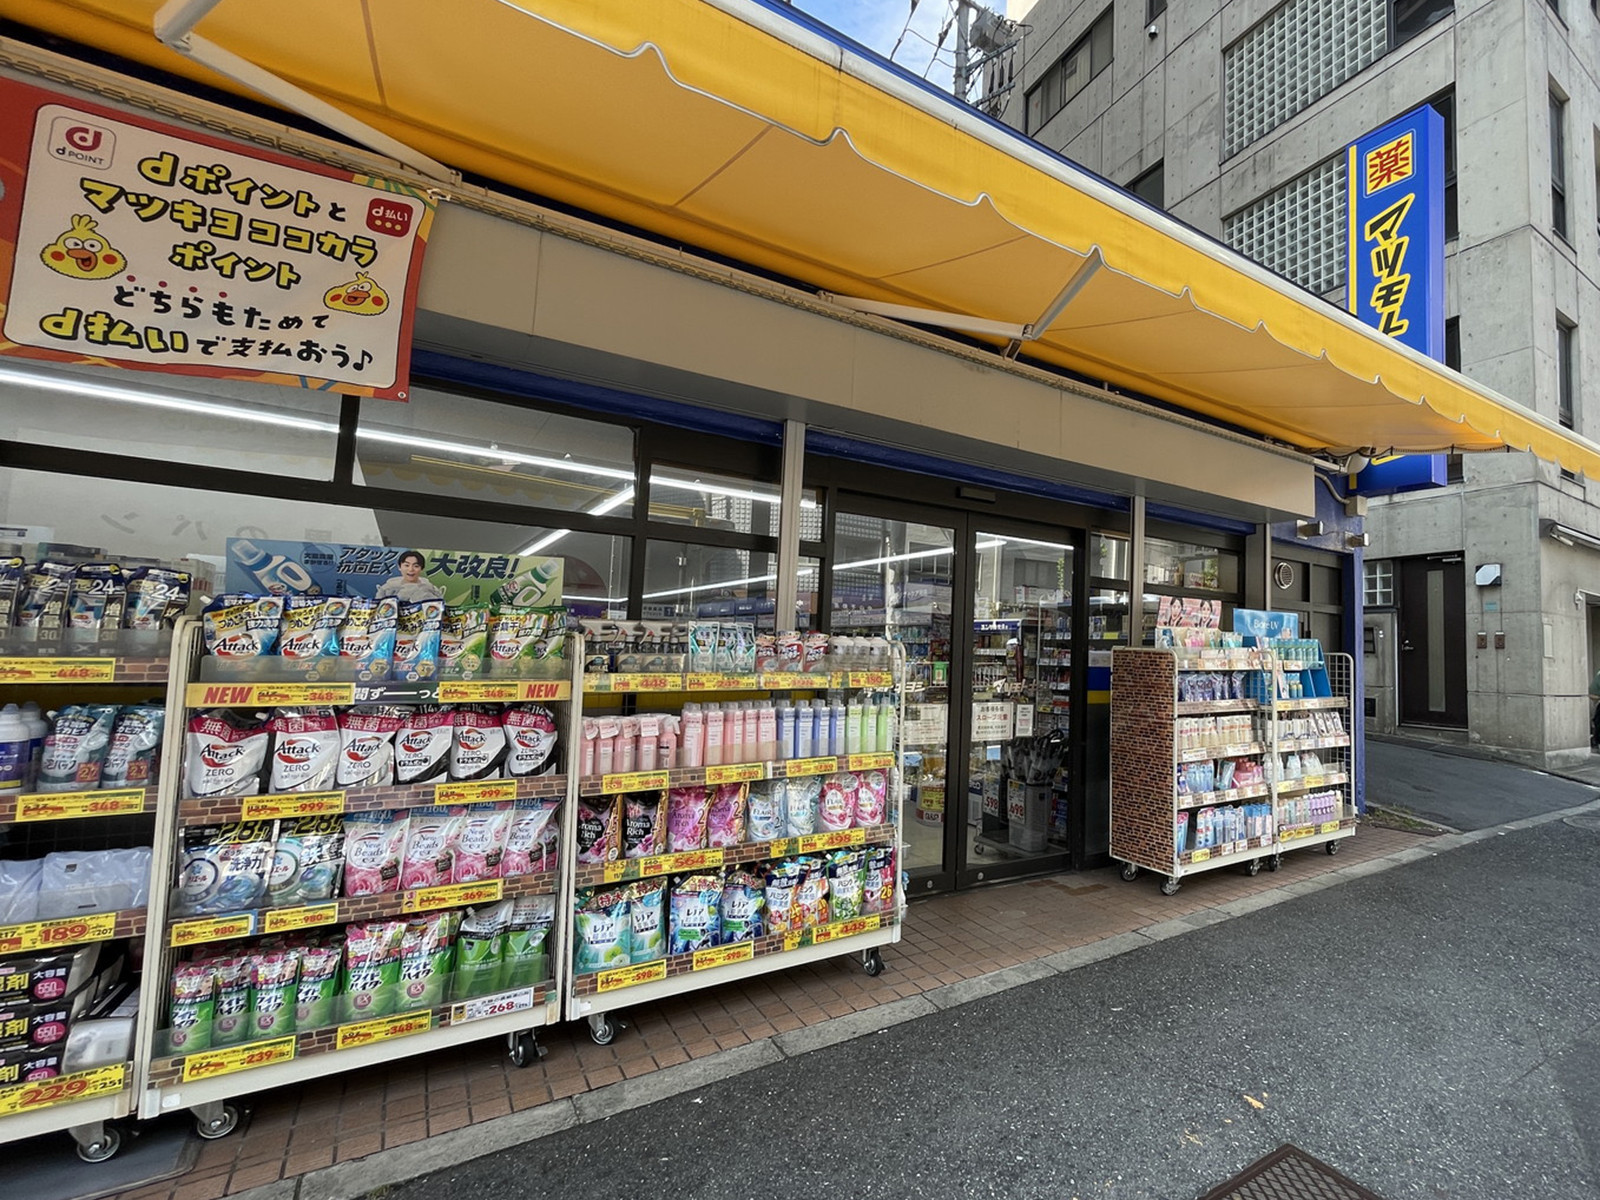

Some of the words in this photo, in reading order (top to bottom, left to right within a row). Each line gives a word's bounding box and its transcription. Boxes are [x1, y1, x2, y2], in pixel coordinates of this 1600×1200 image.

[66, 150, 105, 166] POINT
[1369, 139, 1409, 191] 薬
[138, 151, 347, 222] dポイントと
[371, 204, 409, 223] d払い
[80, 177, 378, 267] マツキヨココカラ
[169, 240, 301, 290] ポイント
[1365, 193, 1415, 336] マツモト
[114, 283, 330, 331] どちらもためて
[339, 546, 400, 561] アタック
[426, 553, 520, 580] 大改良!
[89, 579, 117, 595] 24
[151, 584, 180, 600] 24
[213, 638, 259, 652] Attack
[202, 687, 253, 704] NEW
[308, 692, 334, 701] 348
[525, 684, 559, 699] NEW
[400, 731, 434, 746] Attack
[274, 738, 321, 755] Attack
[283, 764, 311, 773] ZERO
[348, 761, 372, 770] ZERO
[205, 768, 235, 777] ZERO
[481, 789, 502, 798] 999
[88, 801, 120, 812] 348
[299, 802, 325, 812] 999
[752, 808, 772, 816] FLAIR
[516, 826, 530, 834] New
[626, 828, 644, 836] Rich
[419, 833, 437, 842] New
[461, 834, 489, 843] Beads
[509, 833, 532, 841] Beads
[827, 835, 852, 846] 498
[363, 840, 381, 849] New
[412, 841, 439, 850] Beads
[354, 848, 384, 858] Beads
[674, 855, 707, 868] 564
[461, 891, 485, 901] 369
[880, 885, 893, 899] 26
[303, 914, 324, 924] 980
[40, 923, 90, 944] 189
[213, 925, 236, 936] 980
[841, 921, 867, 933] 448
[402, 960, 432, 972] ワイド
[33, 967, 67, 980] 大容量
[352, 970, 381, 983] ワイド
[38, 981, 57, 994] 550
[216, 997, 247, 1008] ワイド
[257, 993, 284, 1005] ワイド
[172, 1008, 198, 1021] ワイド
[488, 1002, 515, 1015] 268
[33, 1011, 67, 1025] 大容量
[37, 1025, 57, 1037] 550
[389, 1024, 413, 1036] 348
[247, 1050, 273, 1064] 239
[23, 1057, 58, 1071] 大容量
[19, 1079, 89, 1108] 229
[99, 1078, 123, 1090] 251
